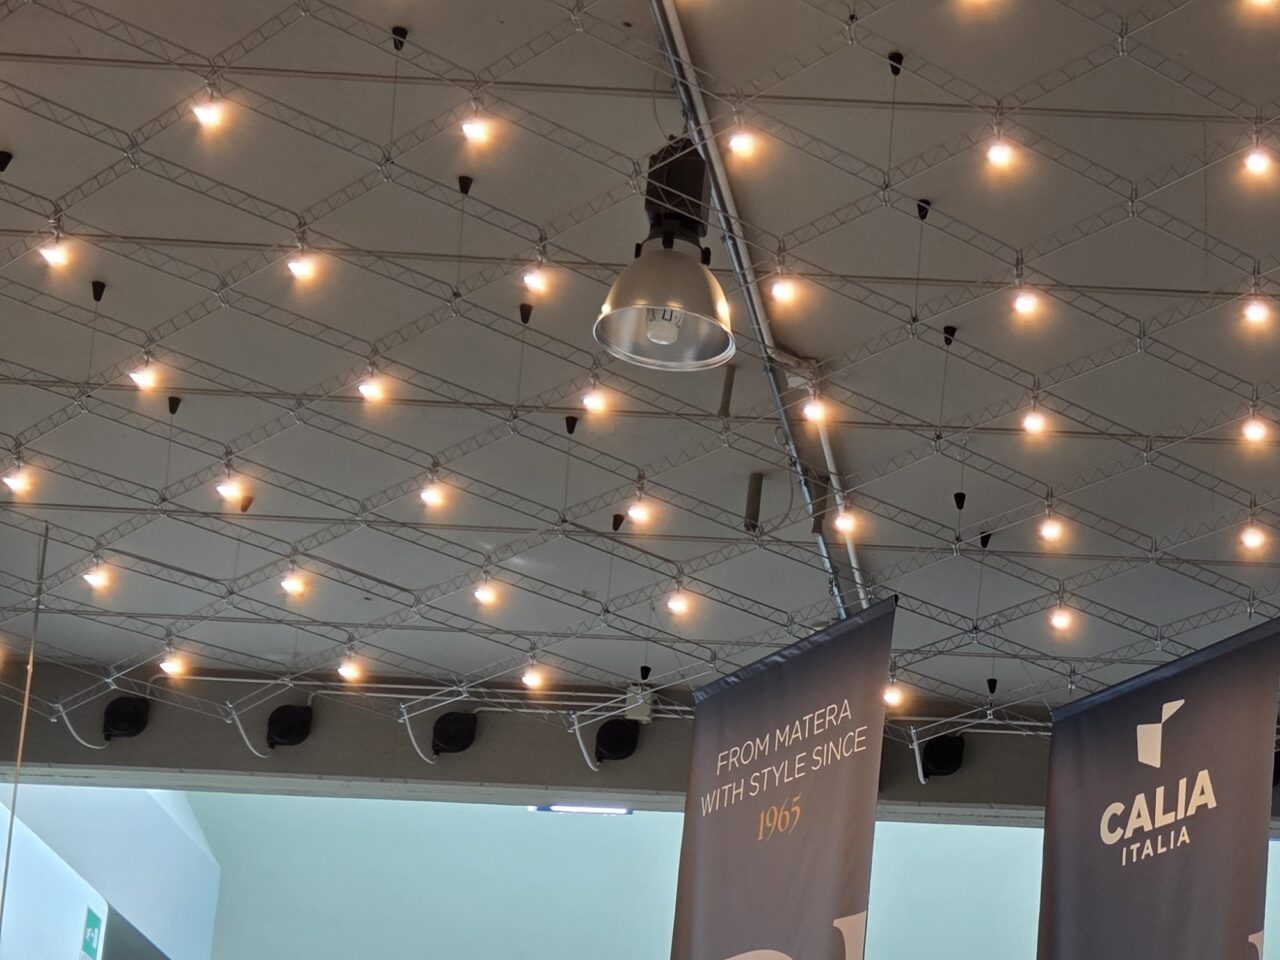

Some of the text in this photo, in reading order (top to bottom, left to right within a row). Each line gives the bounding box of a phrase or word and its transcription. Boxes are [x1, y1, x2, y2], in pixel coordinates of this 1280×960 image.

[701, 726, 867, 816] WITH STYLE SINCE
[717, 699, 851, 776] FROM MATERA
[758, 792, 802, 841] 1965
[1100, 769, 1217, 845] CALIA
[1122, 826, 1190, 866] ITALIA
